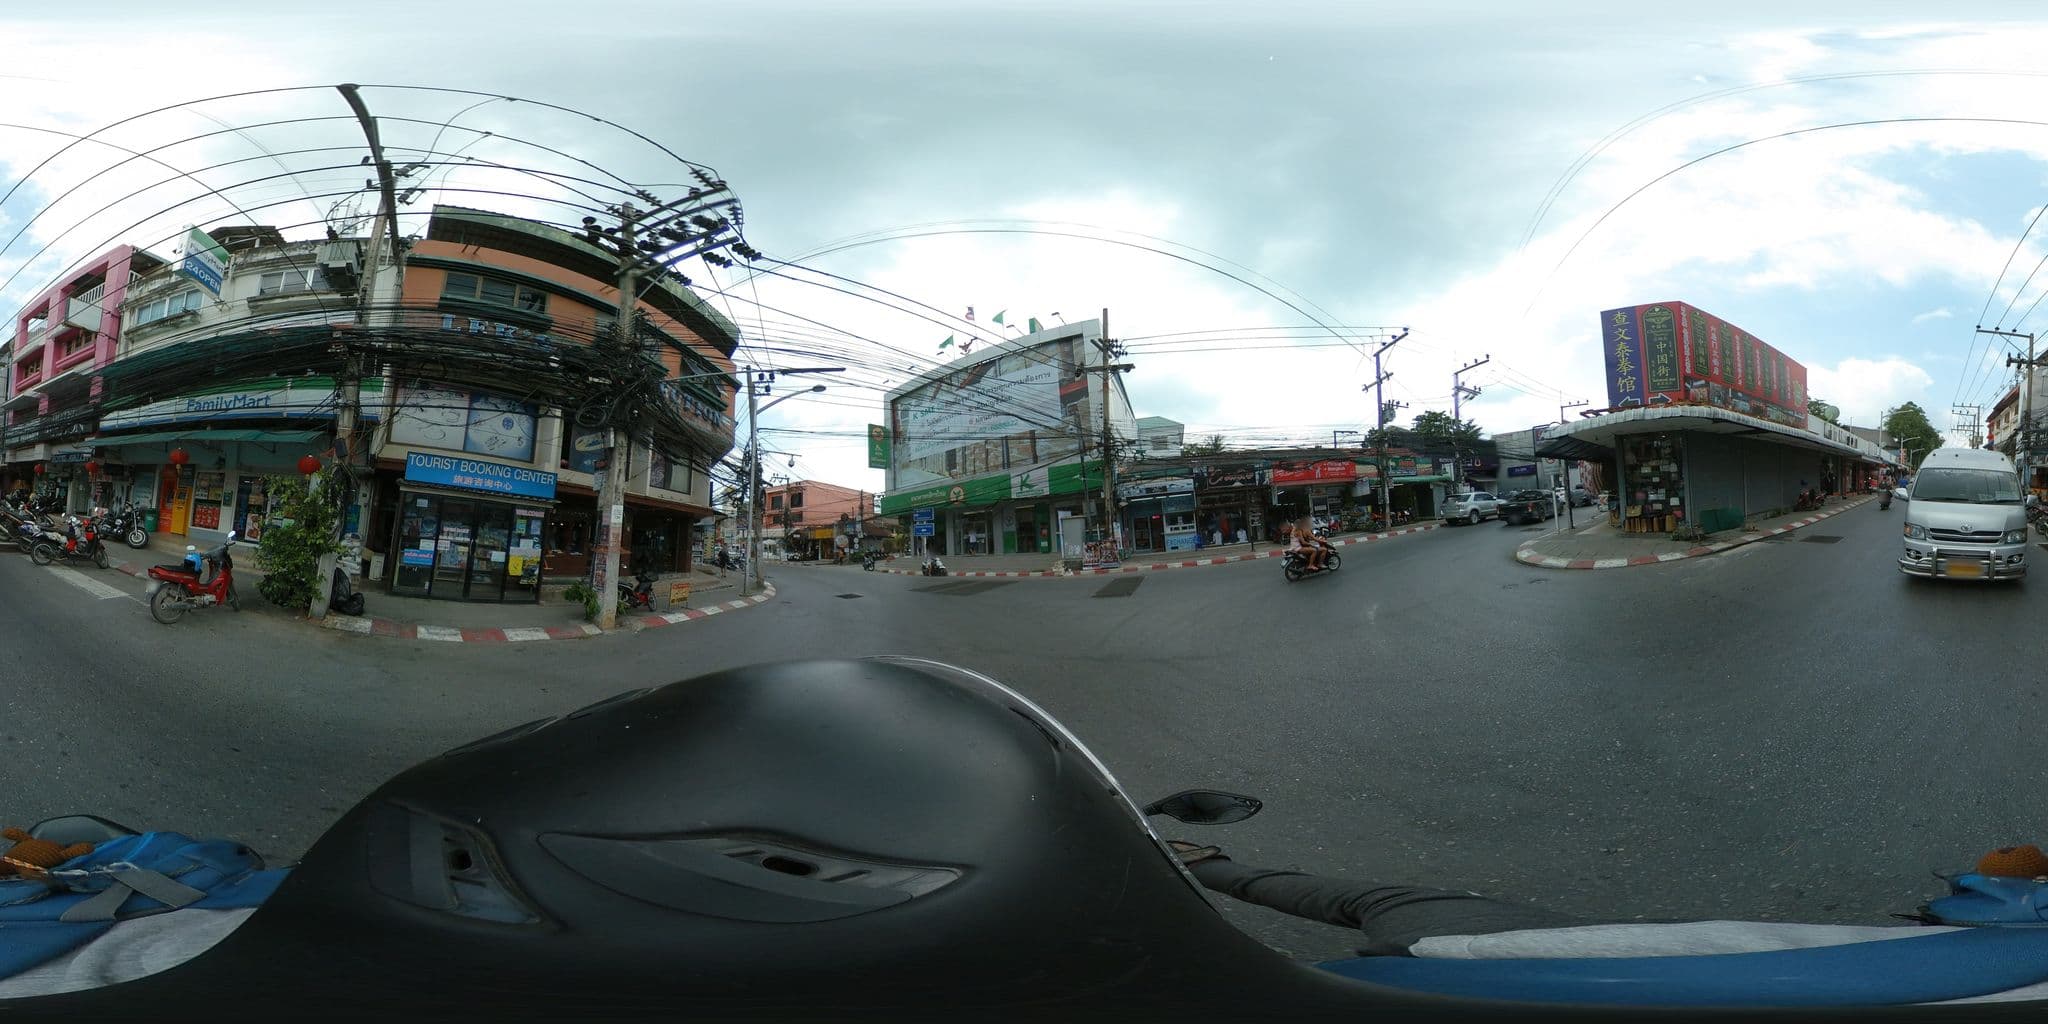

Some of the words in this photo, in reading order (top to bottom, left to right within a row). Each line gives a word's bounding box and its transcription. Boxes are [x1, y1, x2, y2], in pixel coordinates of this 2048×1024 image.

[186, 394, 271, 412] FamilyMart
[409, 454, 458, 470] TOURIST
[460, 461, 511, 478] BOOKING
[514, 469, 554, 485] CENTER
